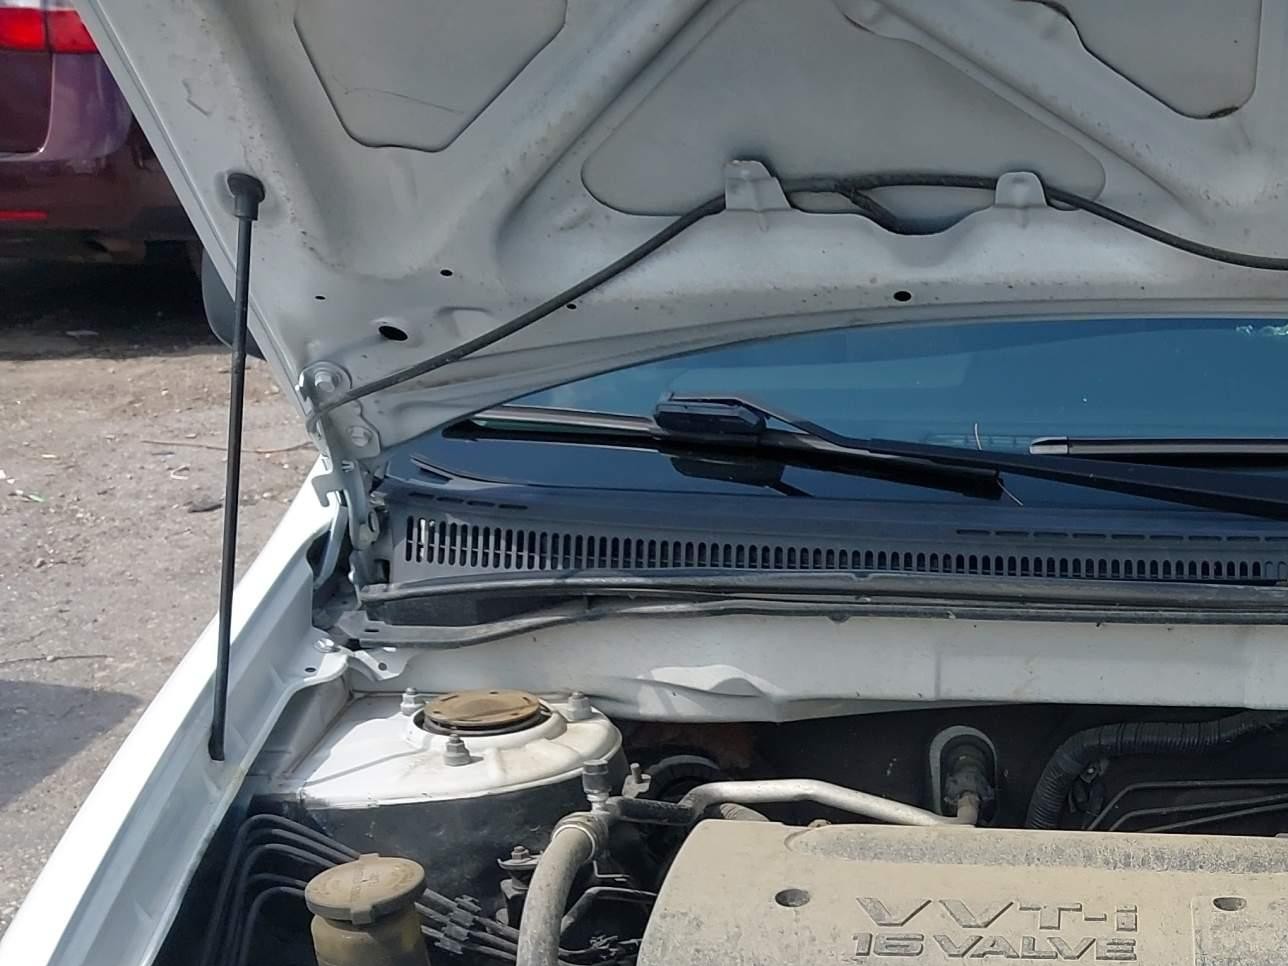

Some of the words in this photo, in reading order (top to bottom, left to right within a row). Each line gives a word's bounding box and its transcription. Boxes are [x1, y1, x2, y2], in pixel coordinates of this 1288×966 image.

[856, 896, 1138, 932] VVT-i
[852, 932, 924, 957] 16
[933, 934, 1138, 961] VALVE
